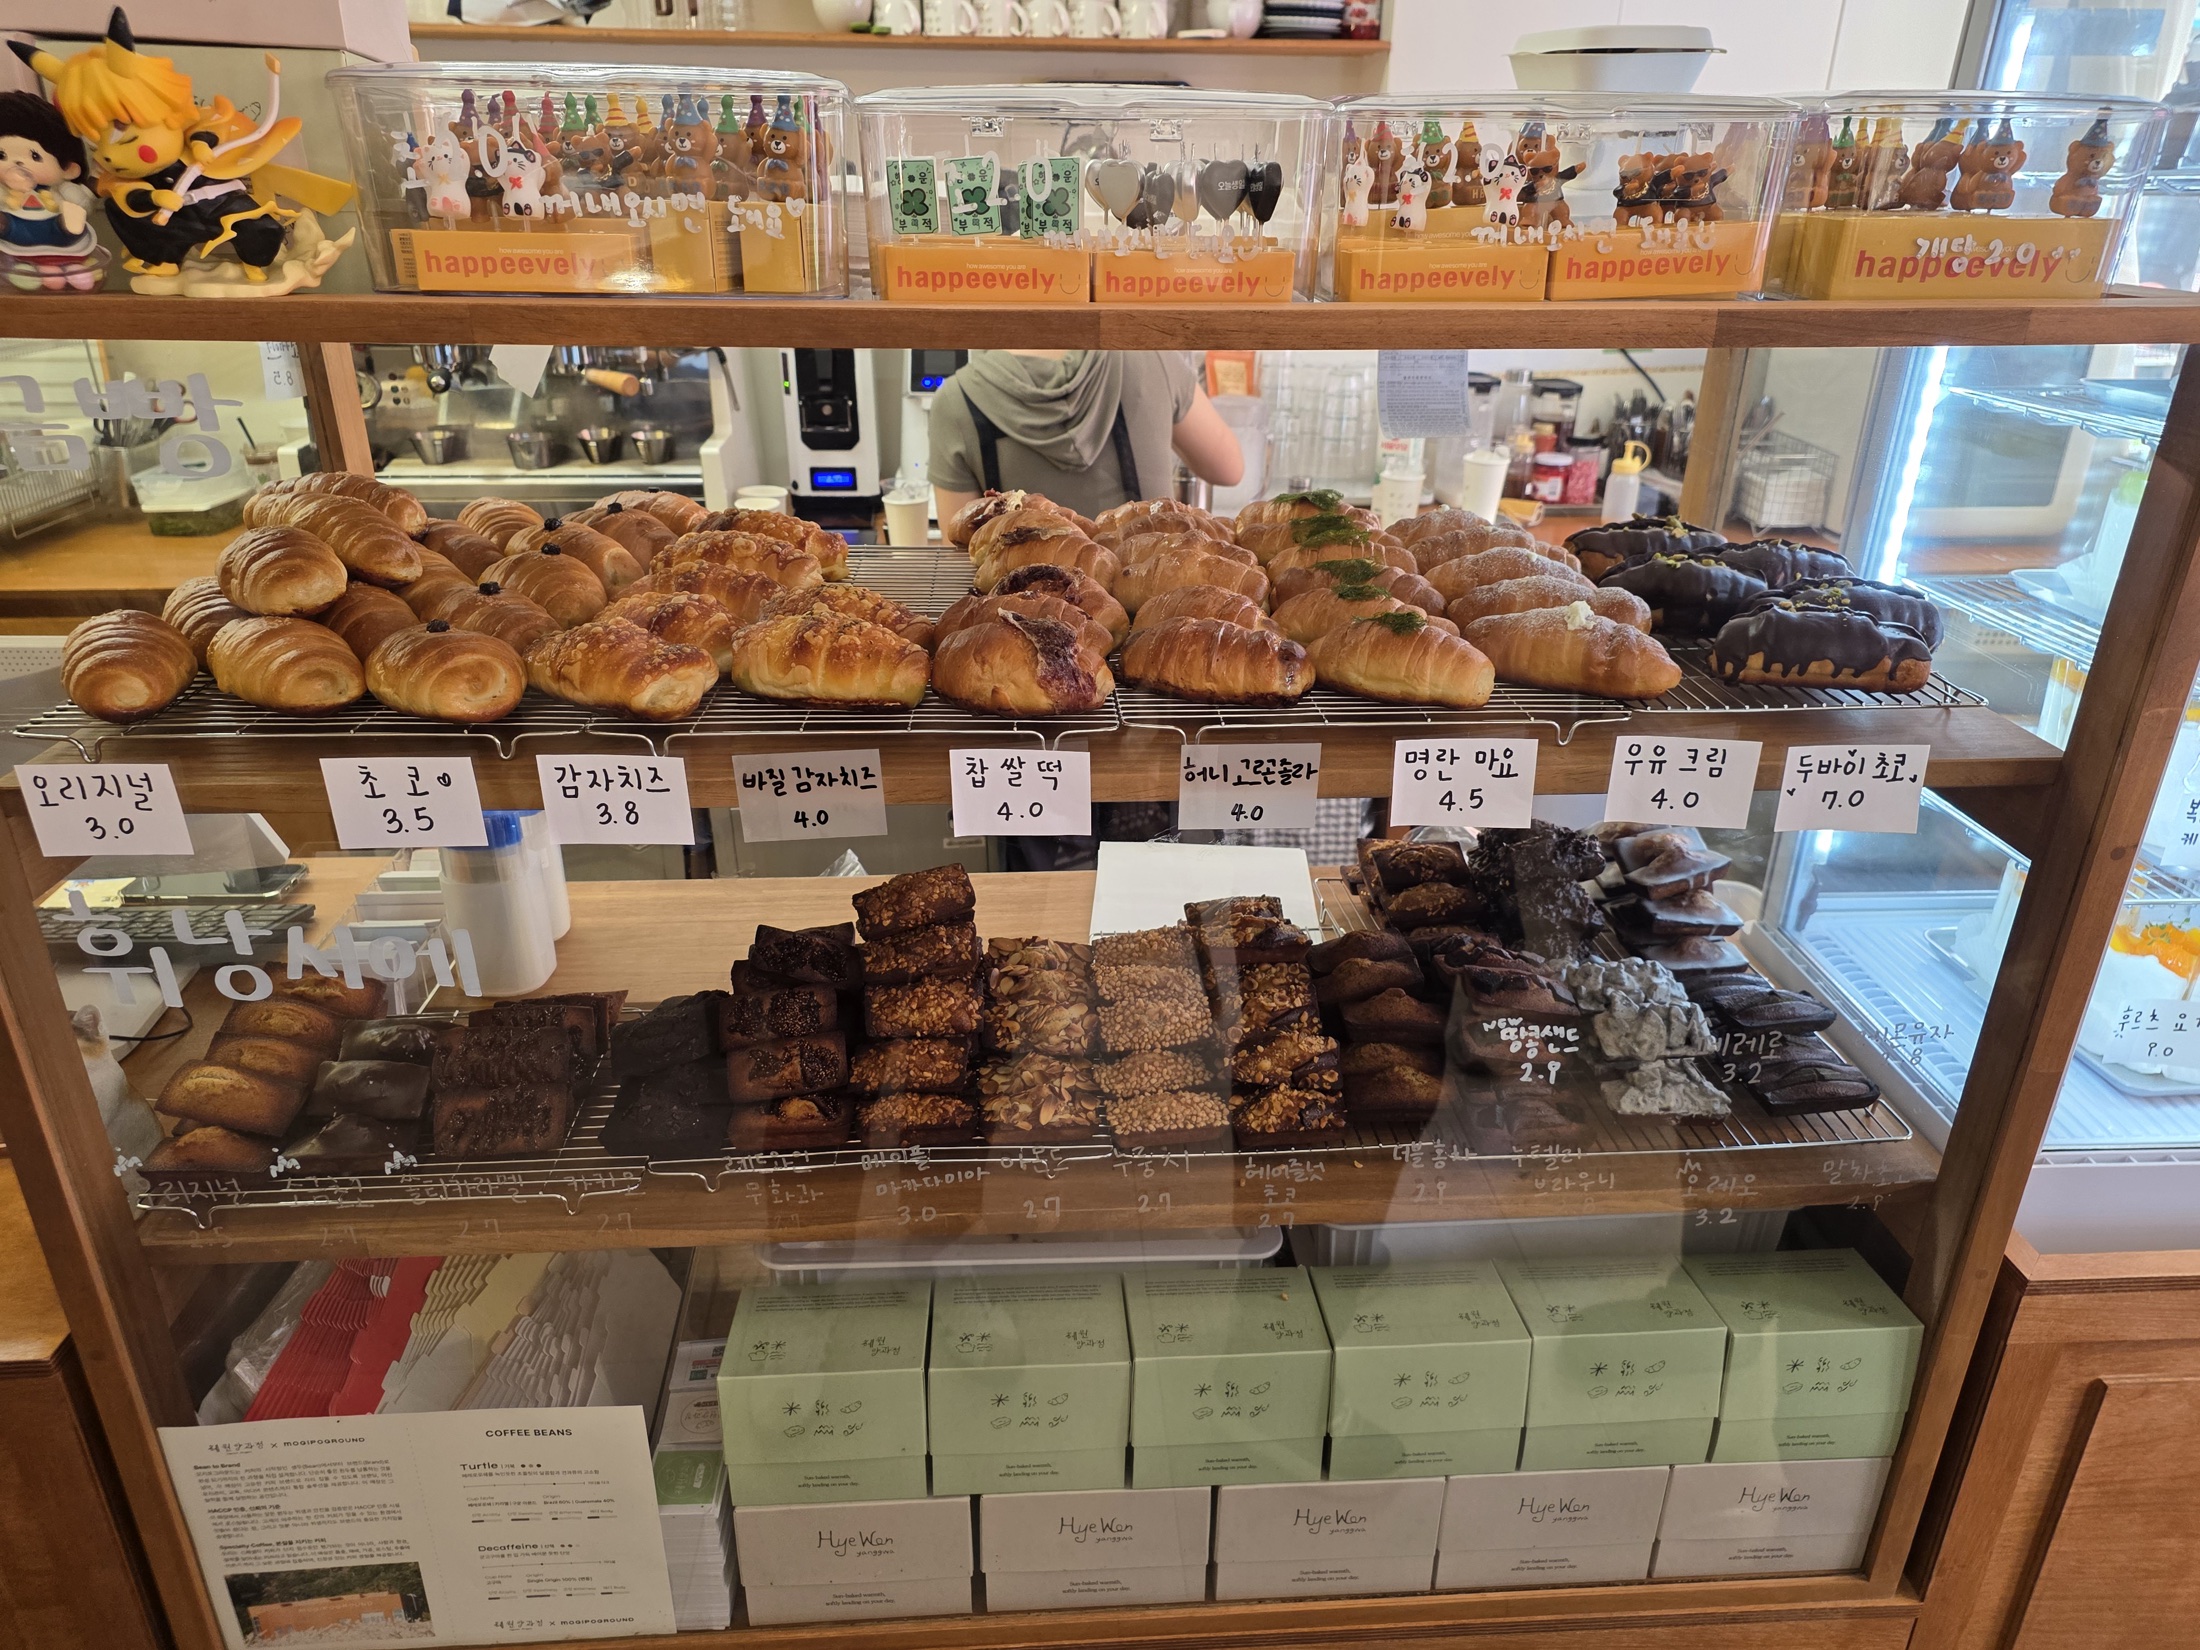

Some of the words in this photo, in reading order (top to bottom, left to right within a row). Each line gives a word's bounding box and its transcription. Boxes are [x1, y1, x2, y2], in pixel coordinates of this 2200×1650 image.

[1441, 142, 1505, 183] 2.0
[982, 150, 1053, 206] 2.0
[424, 249, 596, 279] happeevely
[1566, 252, 1731, 281] happeevely
[1916, 233, 1975, 274] 개당
[1984, 238, 2036, 266] 2.0
[897, 266, 1055, 293] happeevely
[1105, 271, 1260, 297] happeevely
[1360, 267, 1516, 293] happeevely
[1184, 757, 1229, 783] 허니
[1404, 748, 1461, 783] 명란
[1474, 747, 1519, 780] 마요
[1623, 743, 1668, 776] 우유
[1678, 746, 1728, 779] 크림
[1796, 753, 1866, 783] 두바이
[31, 774, 156, 811] 오리지널
[555, 763, 672, 800] 감자치즈
[742, 767, 787, 798] 바질
[796, 766, 879, 795] 감자치즈
[996, 801, 1044, 821] 4.0
[1438, 788, 1485, 813] 4.5
[1650, 787, 1699, 810] 4.0
[1821, 789, 1865, 809] 7.0
[381, 805, 435, 834] 3.5
[595, 801, 641, 827] 3.8
[792, 808, 830, 829] 4.0
[1230, 802, 1264, 822] 4.0
[85, 816, 136, 840] 3.0
[52, 889, 483, 1008] 휘낭시에
[2147, 1041, 2175, 1058] 9.0
[1519, 1060, 1562, 1085] 2.9
[1721, 1060, 1763, 1084] 3.2
[861, 1144, 931, 1171] 메이플
[746, 1178, 824, 1205] 무화과
[1534, 1171, 1615, 1197] 브라우니
[897, 1205, 937, 1225] 3.0
[1258, 1211, 1296, 1230] 2.7
[1695, 1207, 1738, 1227] 3.2
[485, 1428, 531, 1438] COFFEE
[533, 1428, 573, 1437] BEANS
[459, 1461, 499, 1471] Turtle
[477, 1543, 539, 1552] Decaffeine
